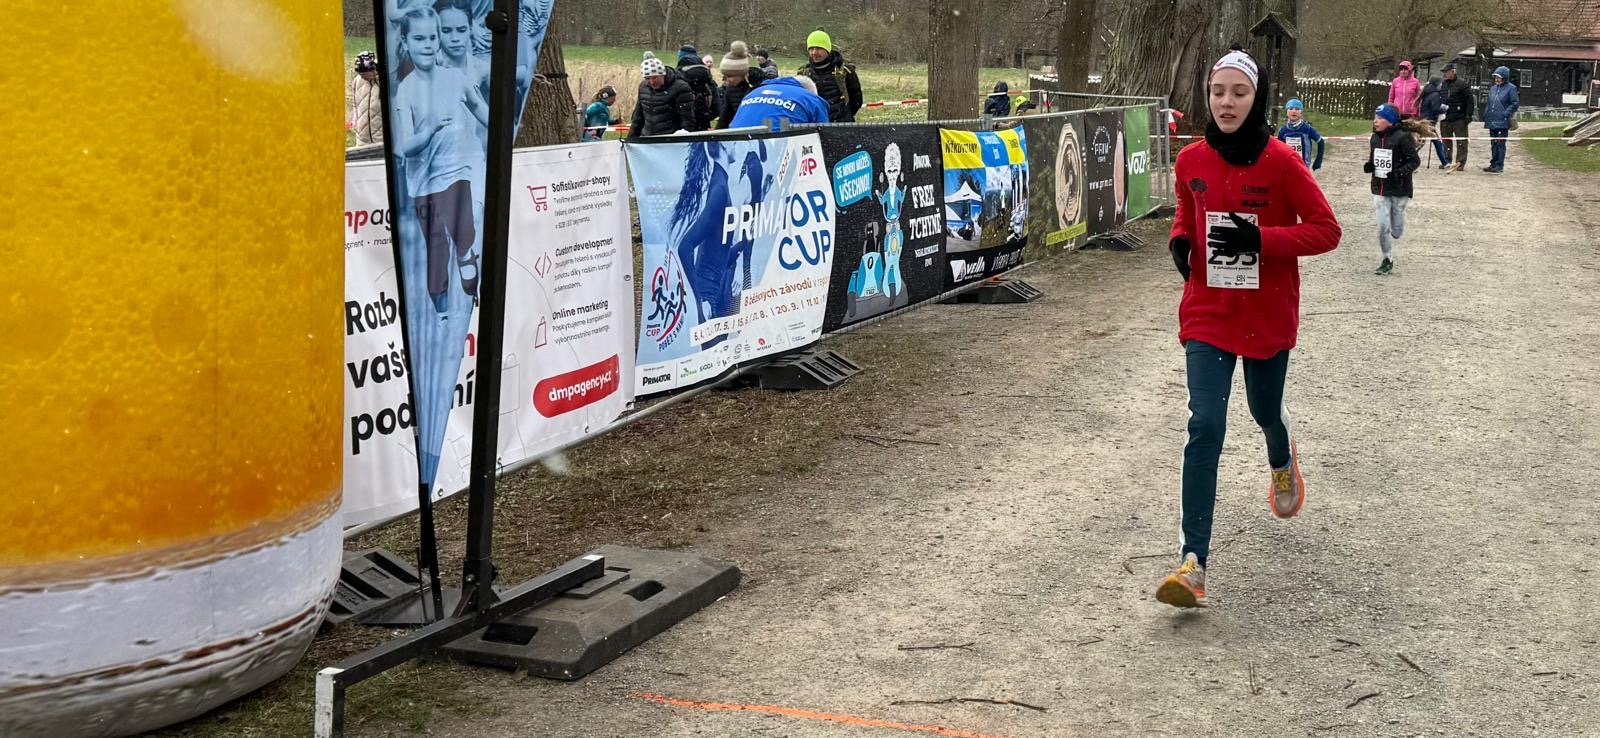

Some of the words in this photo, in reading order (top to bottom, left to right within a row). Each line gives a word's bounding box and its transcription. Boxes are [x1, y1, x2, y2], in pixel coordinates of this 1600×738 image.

[1373, 158, 1392, 169] 386
[839, 172, 870, 203] VŠECHNO!
[911, 184, 935, 209] FREE
[909, 207, 942, 241] TCHYNĚ
[778, 229, 831, 270] CUP
[780, 276, 812, 295] závodů
[552, 307, 576, 321] Online
[577, 299, 609, 316] marketing
